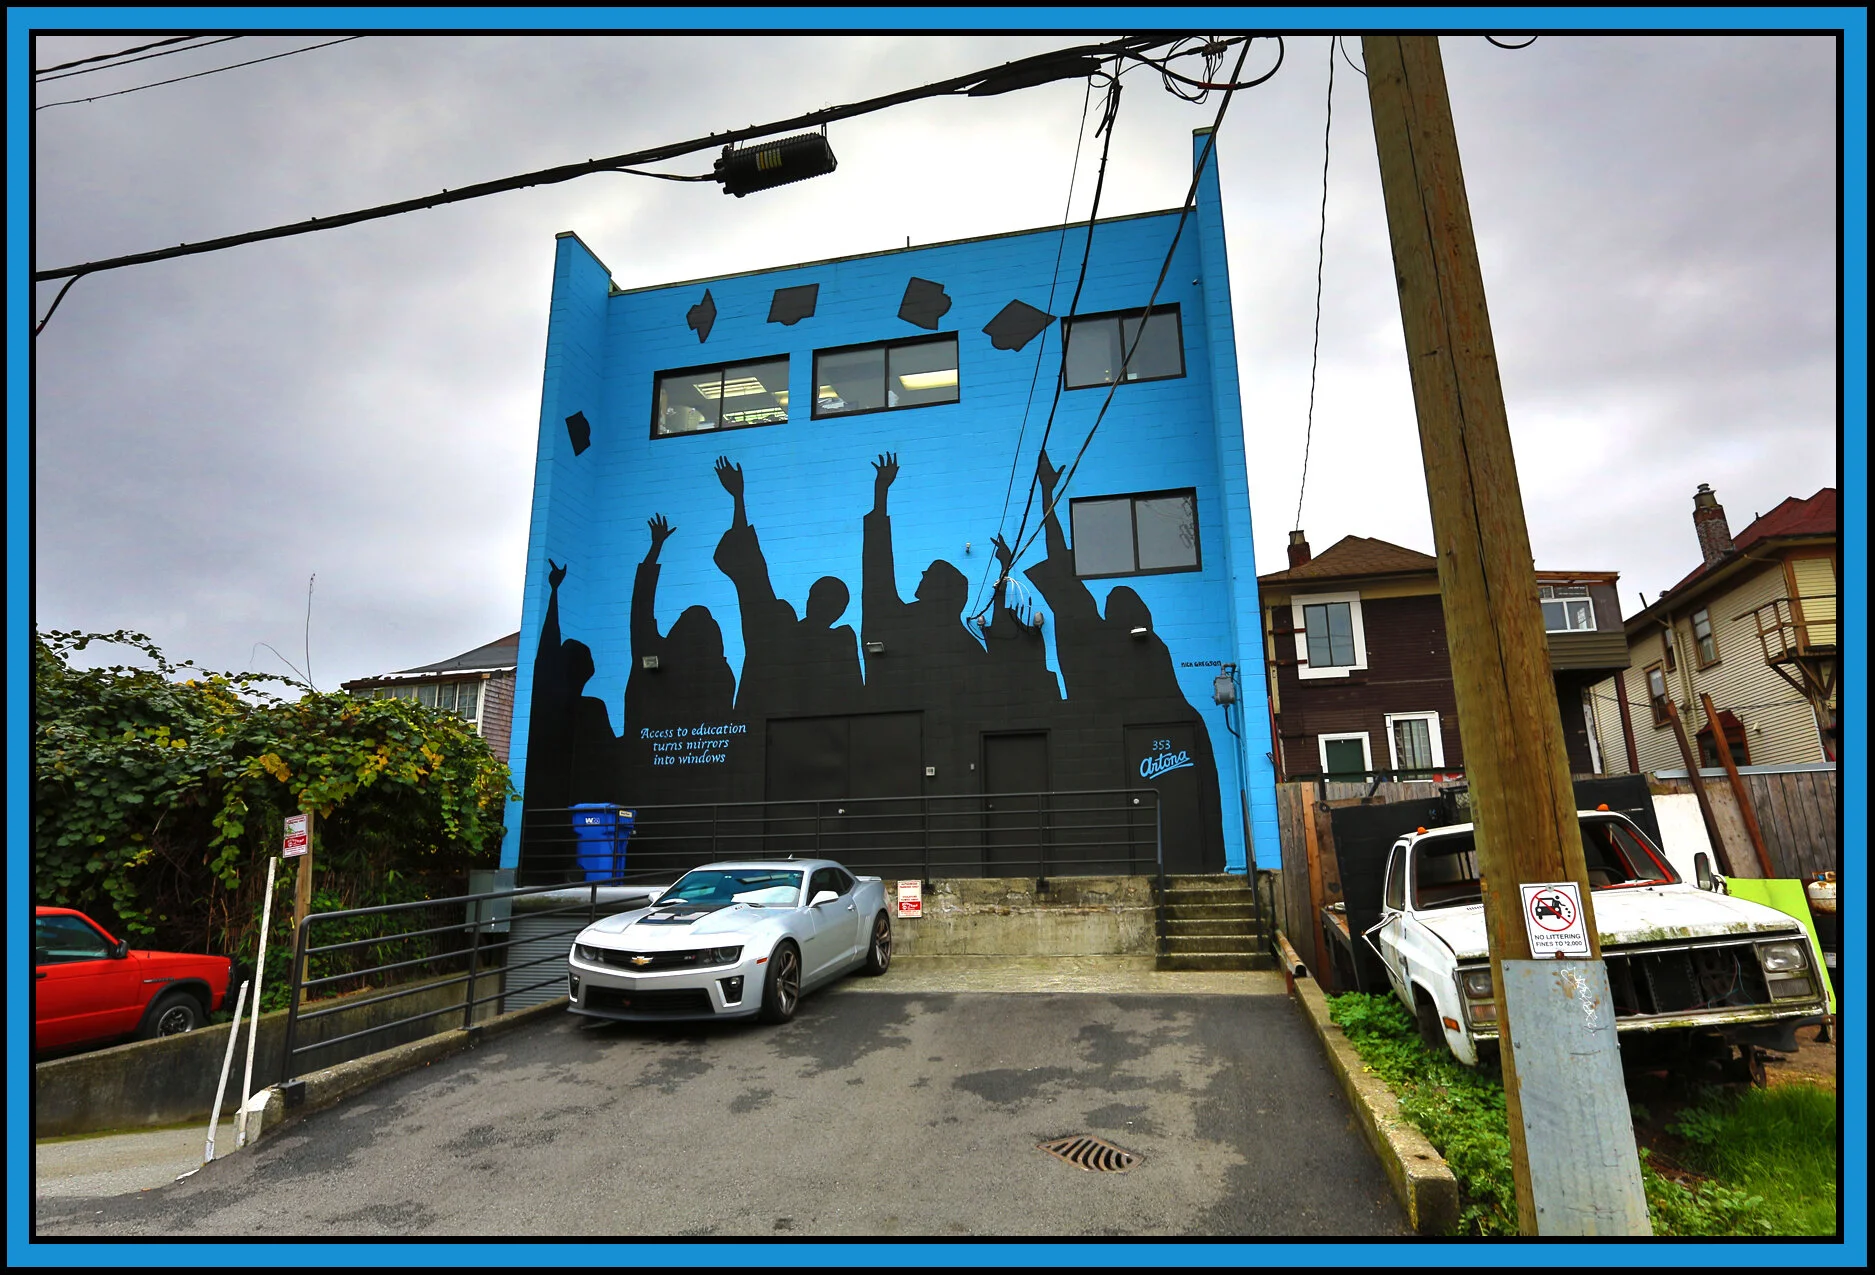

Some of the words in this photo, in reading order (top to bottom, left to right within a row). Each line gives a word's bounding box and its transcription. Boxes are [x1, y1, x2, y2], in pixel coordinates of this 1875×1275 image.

[640, 728, 673, 739] Access
[677, 727, 688, 737] to
[691, 723, 746, 735] education
[653, 742, 682, 751] turns
[686, 738, 729, 749] mirrors
[1152, 740, 1171, 750] 353
[653, 755, 675, 765] into
[679, 749, 725, 764] windows
